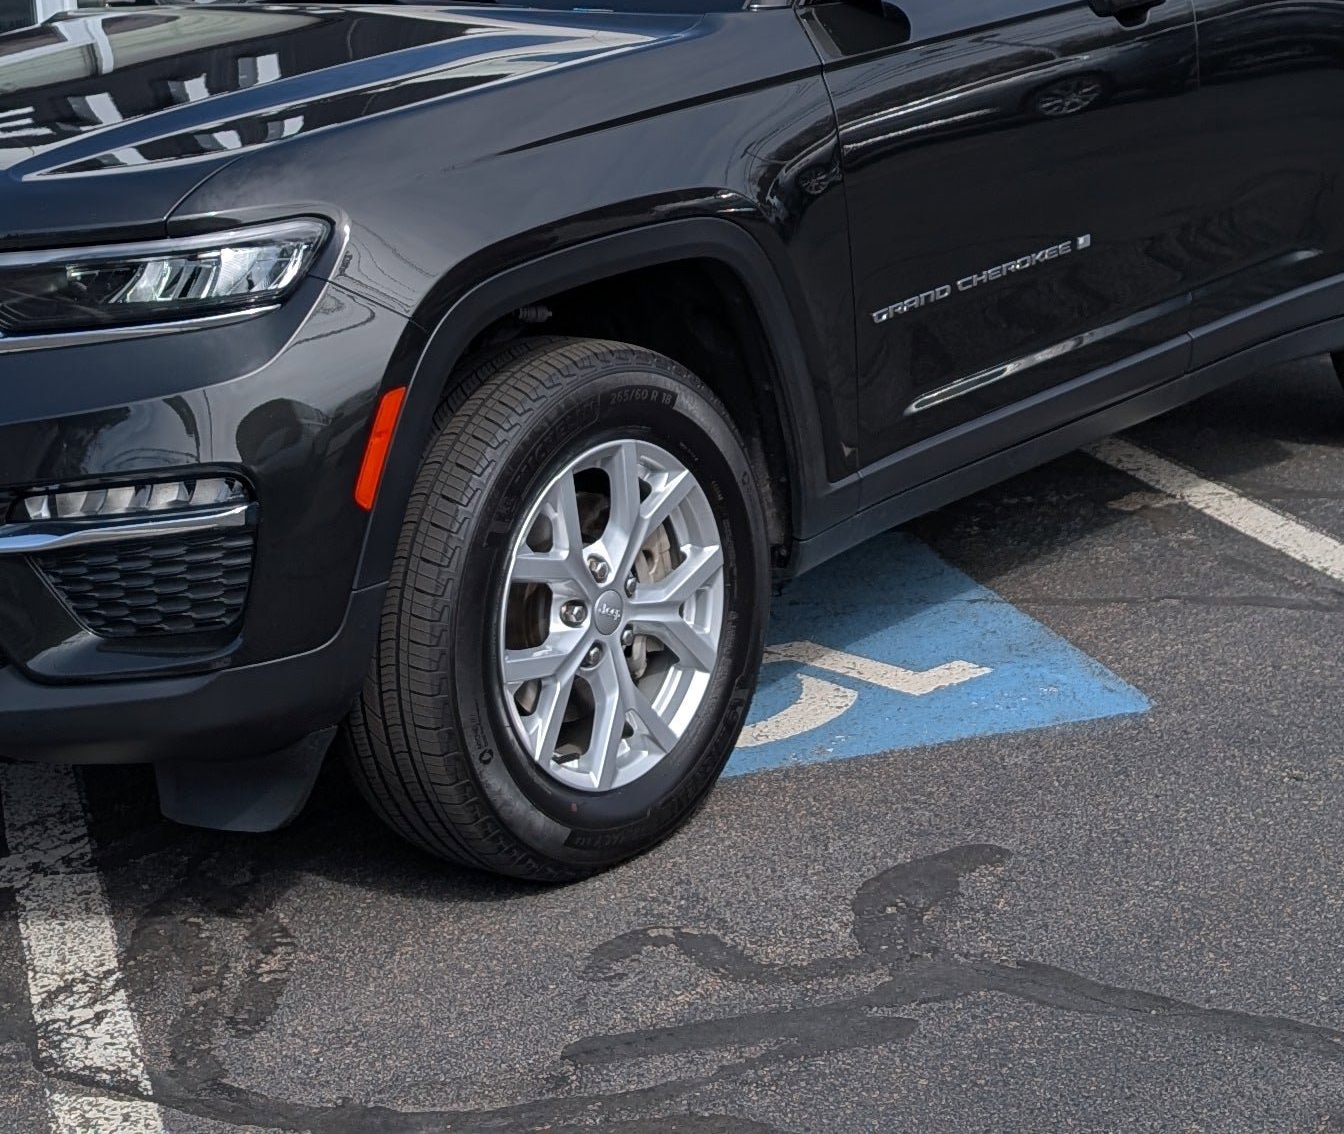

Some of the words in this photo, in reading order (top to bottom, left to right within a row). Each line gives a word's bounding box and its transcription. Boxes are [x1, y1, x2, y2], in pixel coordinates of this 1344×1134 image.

[872, 283, 952, 324] GRAND
[956, 240, 1072, 292] CHEROKEE
[660, 392, 673, 406] 18
